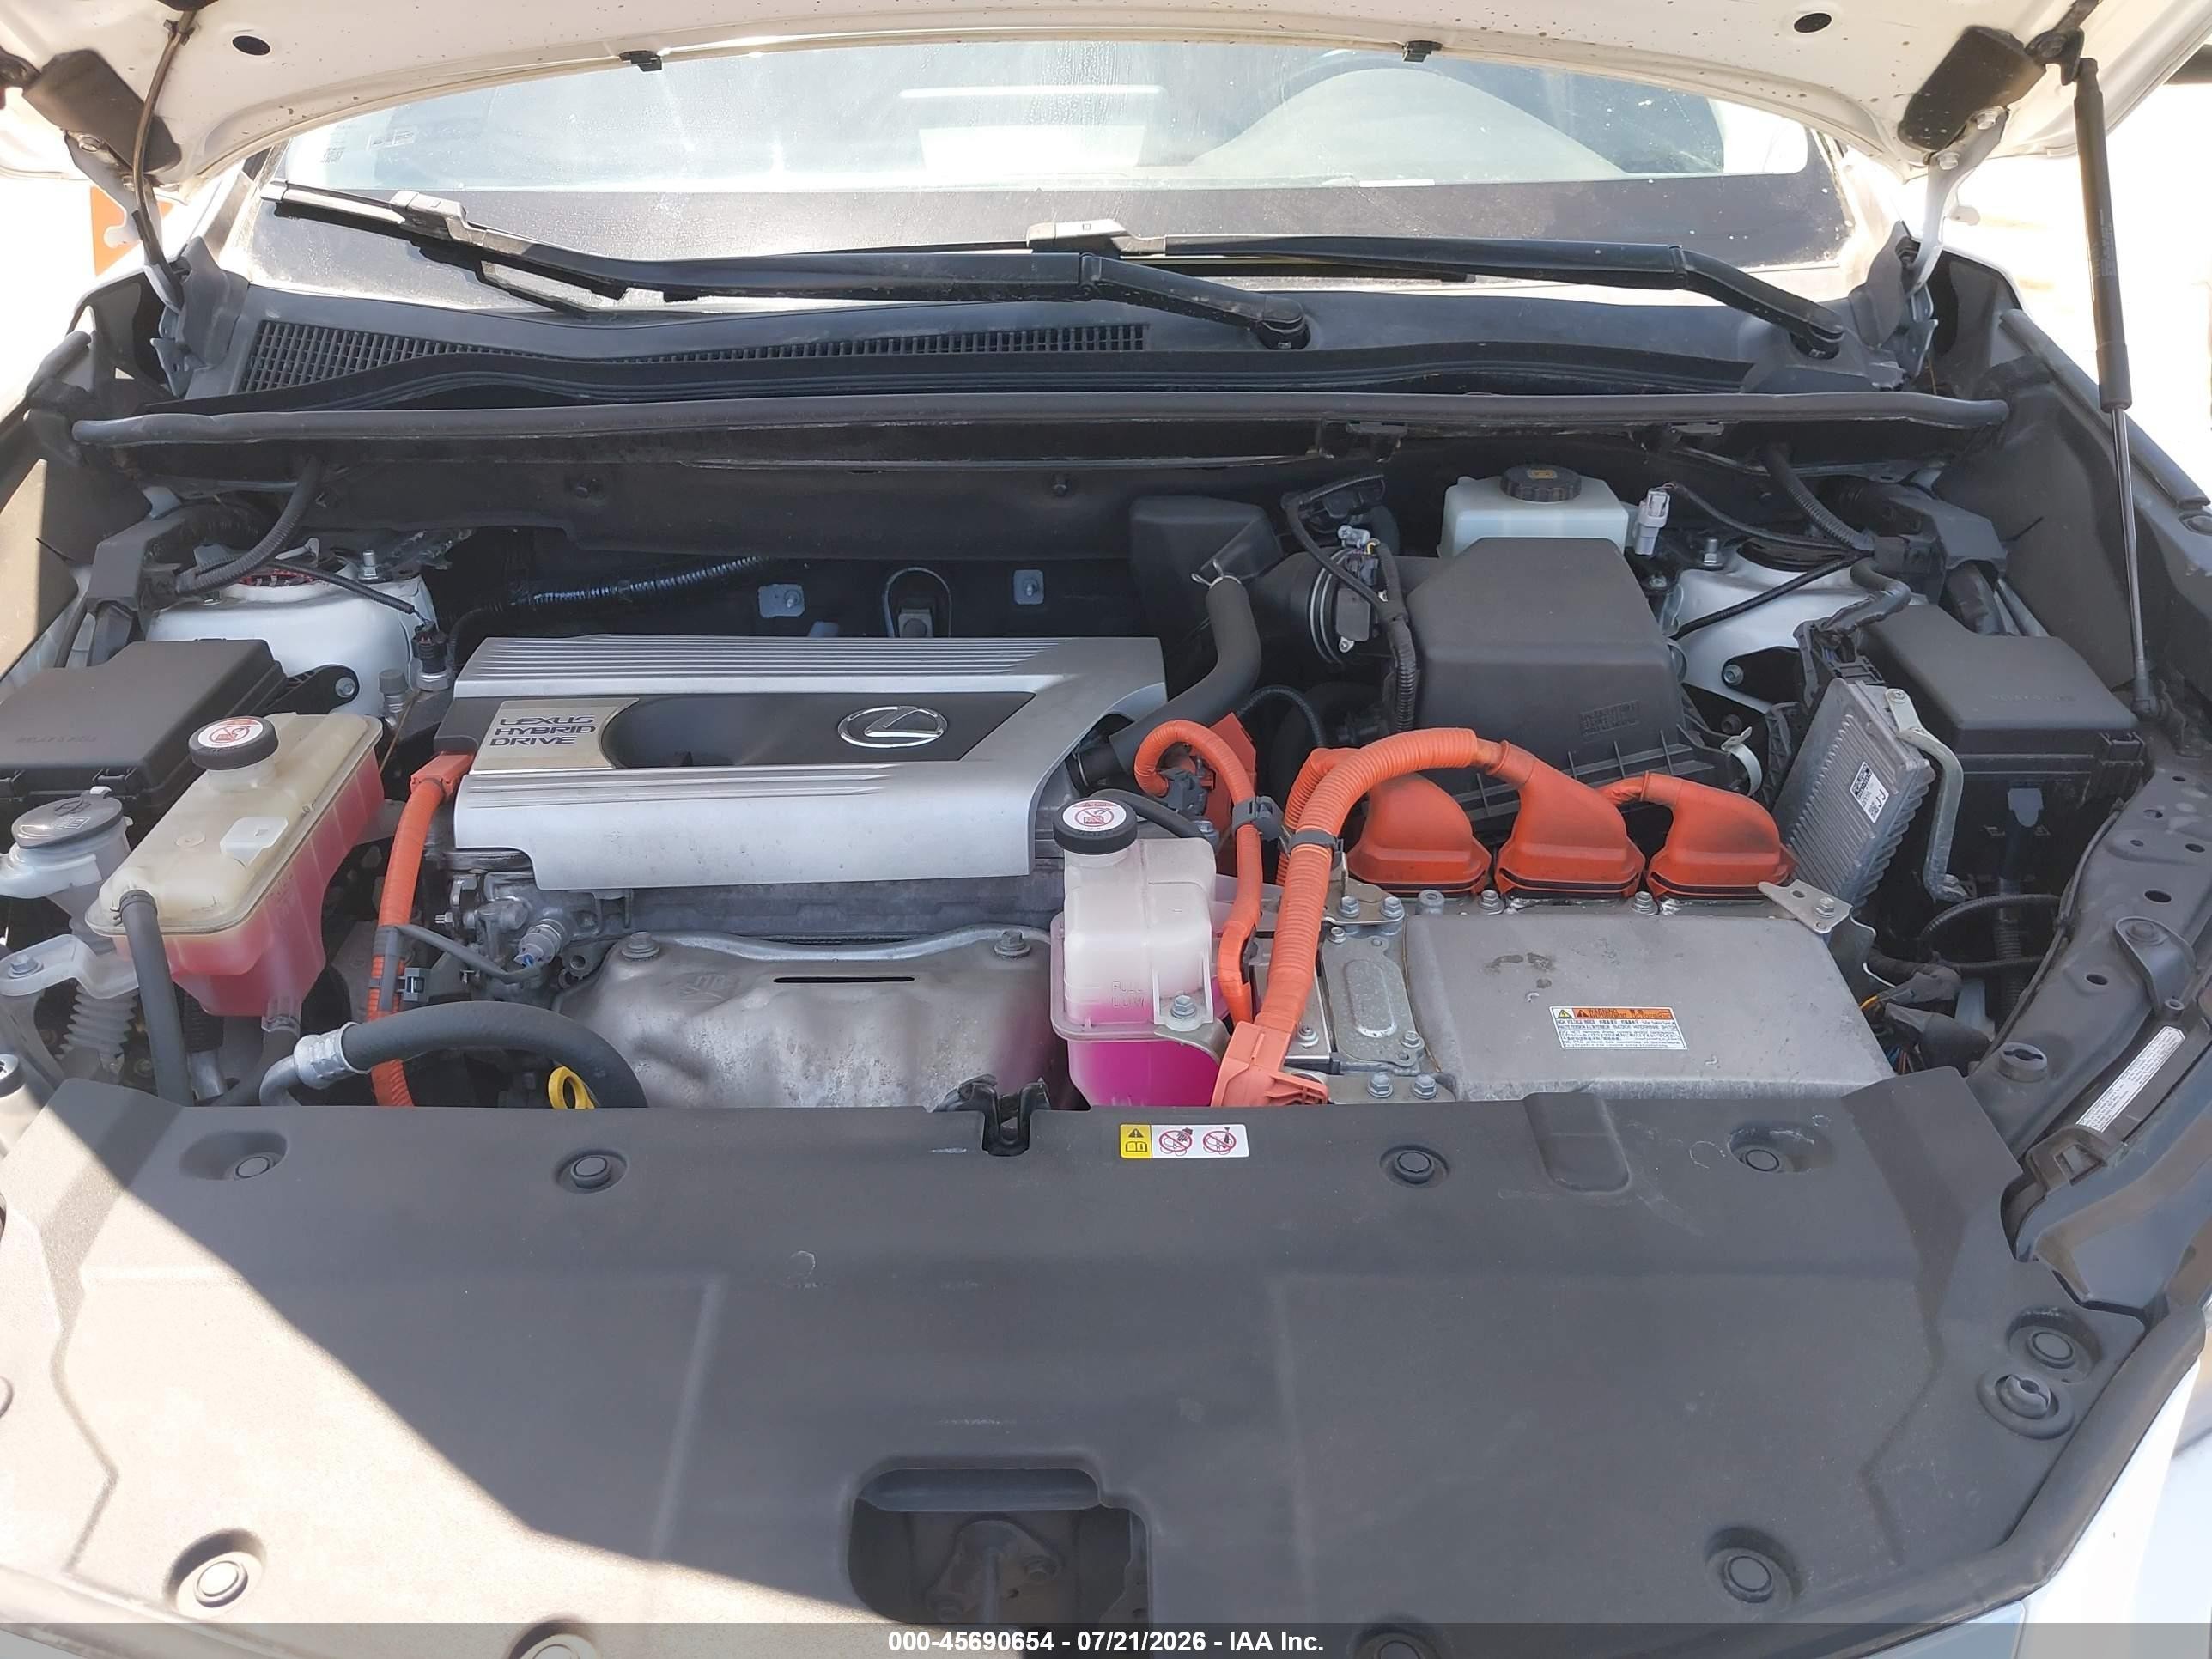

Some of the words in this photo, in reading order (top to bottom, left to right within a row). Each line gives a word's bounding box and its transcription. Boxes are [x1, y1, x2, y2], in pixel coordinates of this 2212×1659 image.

[500, 716, 594, 726] LEXUS
[495, 726, 596, 736] HYBRID
[489, 736, 577, 746] DRIVE
